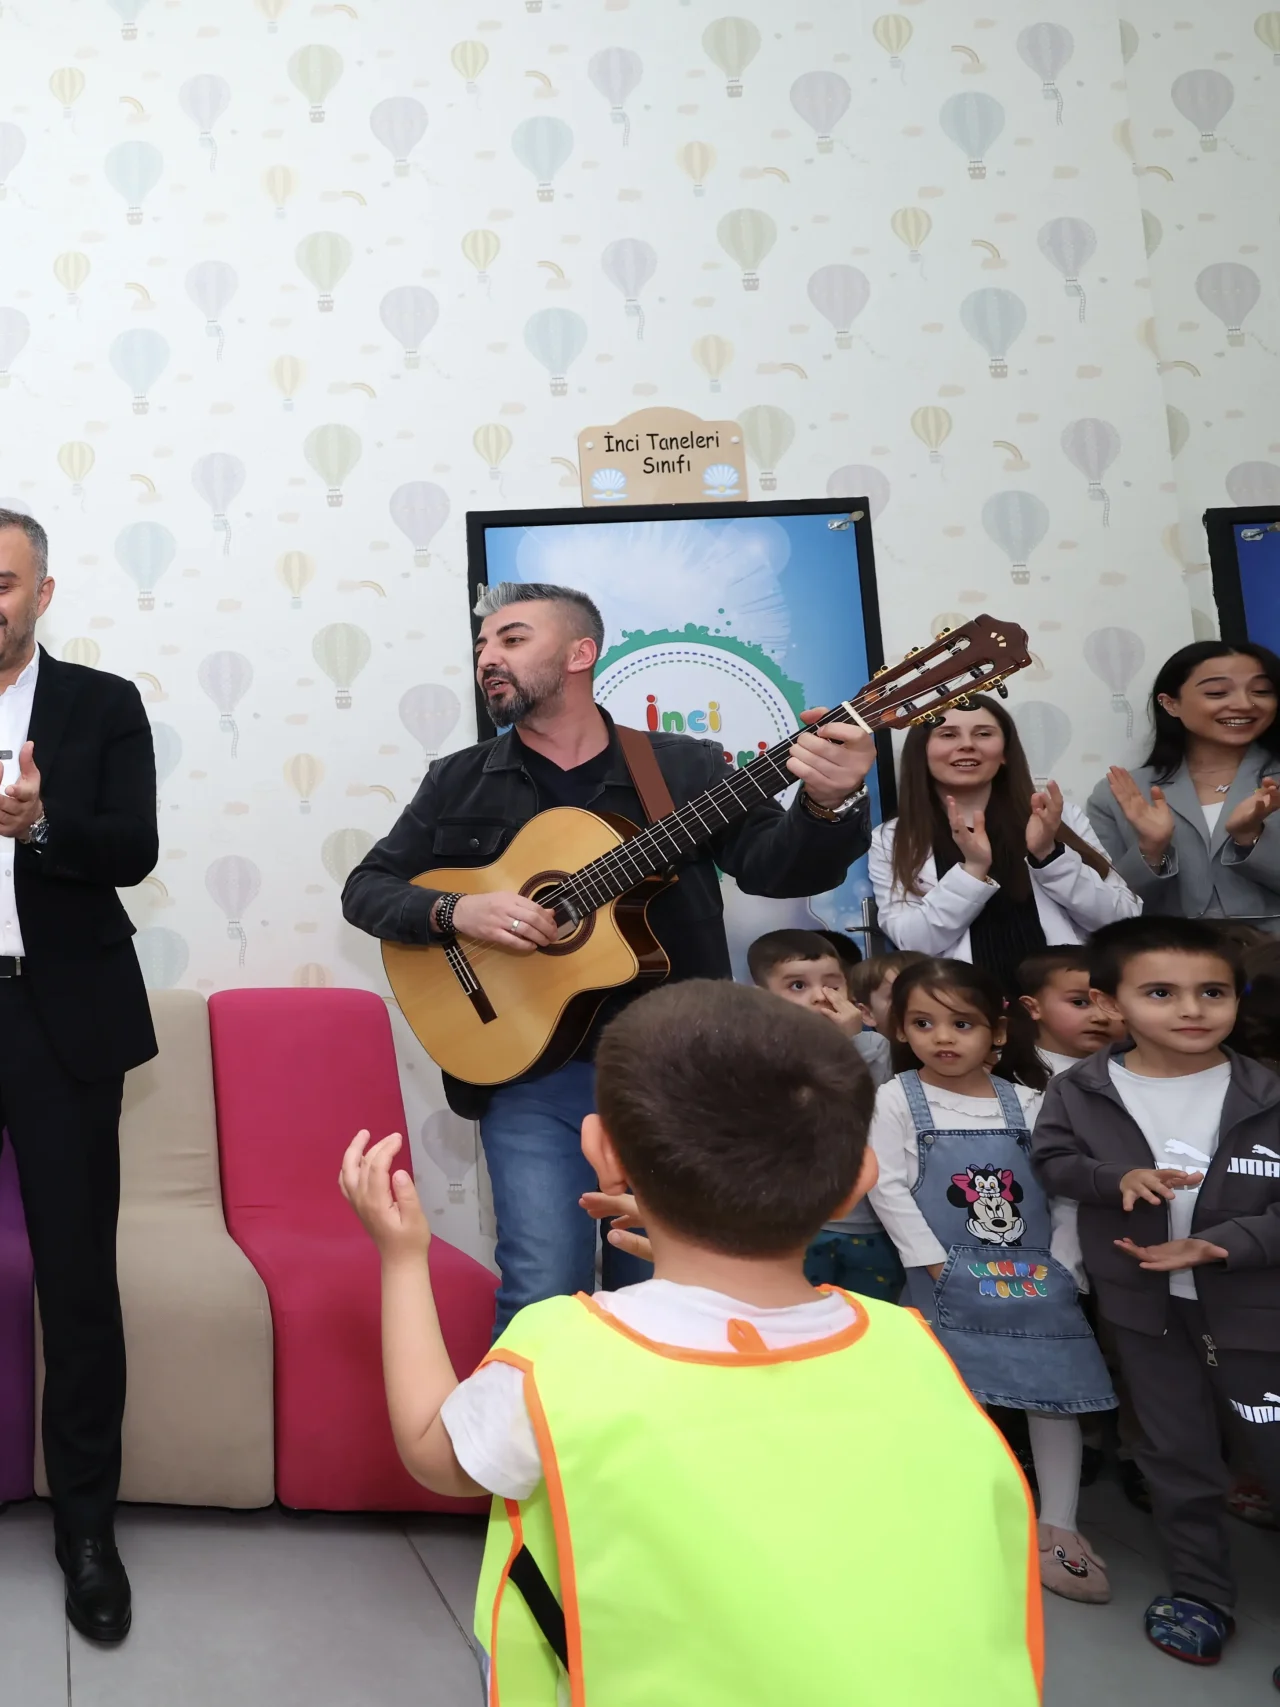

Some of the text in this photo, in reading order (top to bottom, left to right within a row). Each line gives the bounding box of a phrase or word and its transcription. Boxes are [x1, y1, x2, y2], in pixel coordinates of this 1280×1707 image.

[604, 430, 720, 453] İnci Taneleri
[642, 454, 691, 474] Sınıfı
